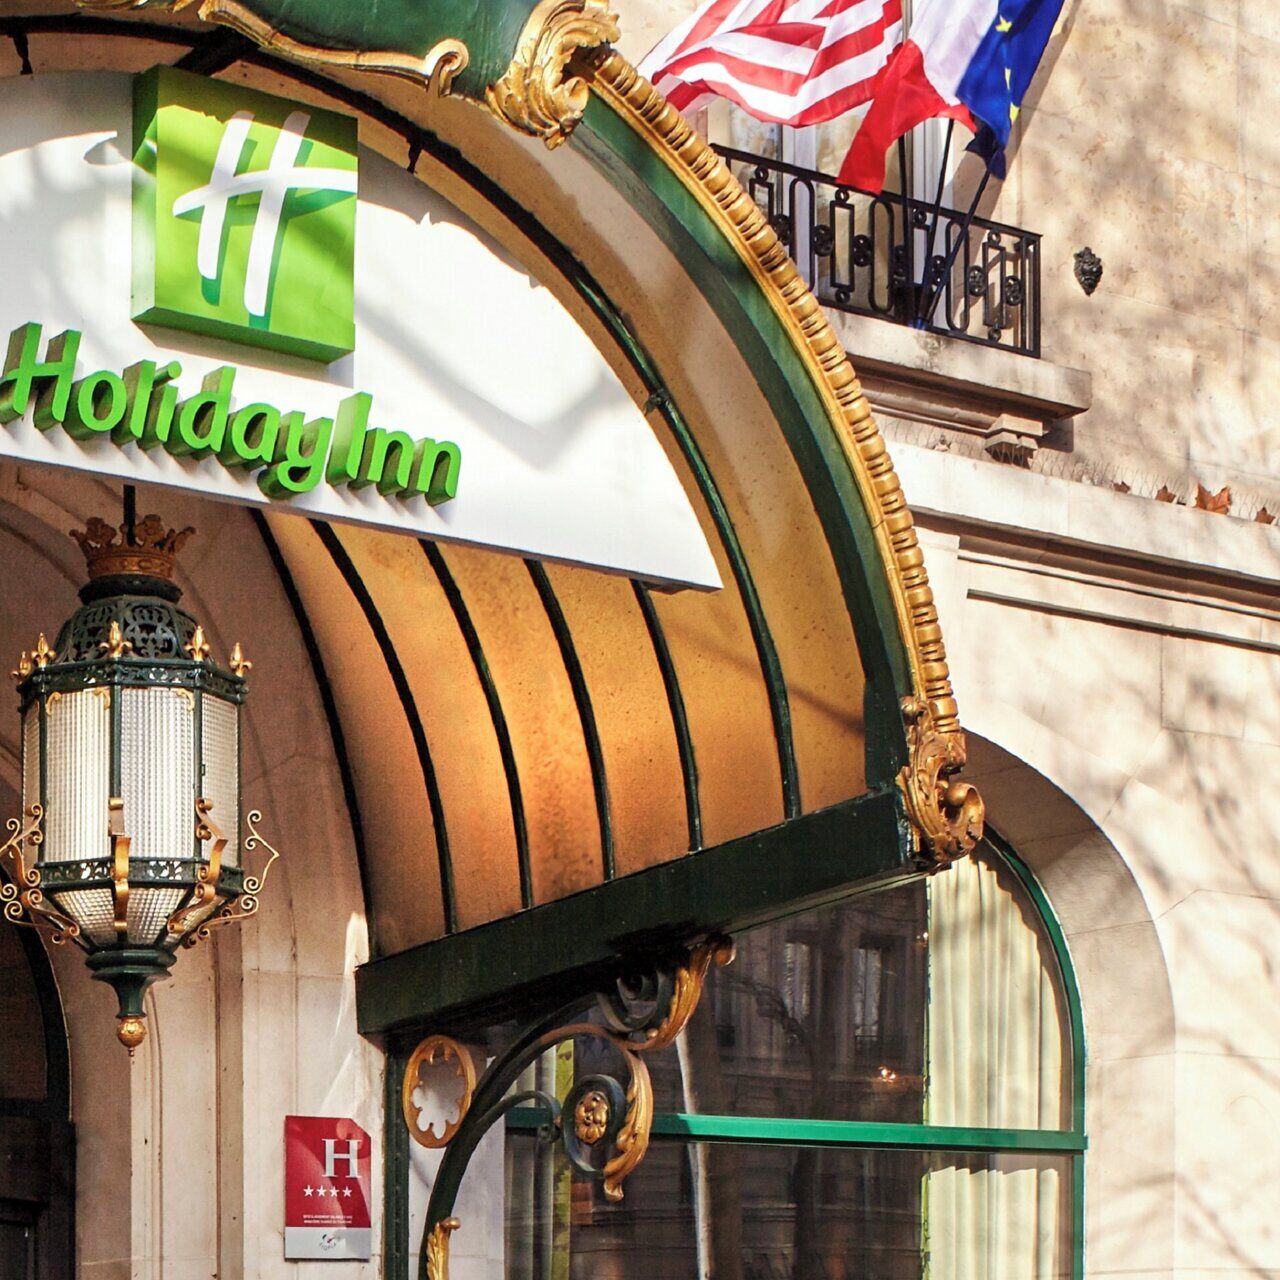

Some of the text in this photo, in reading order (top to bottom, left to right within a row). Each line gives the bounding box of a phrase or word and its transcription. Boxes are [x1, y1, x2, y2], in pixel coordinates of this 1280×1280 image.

[172, 110, 358, 319] H
[328, 392, 462, 506] Inn
[321, 1138, 363, 1179] H
